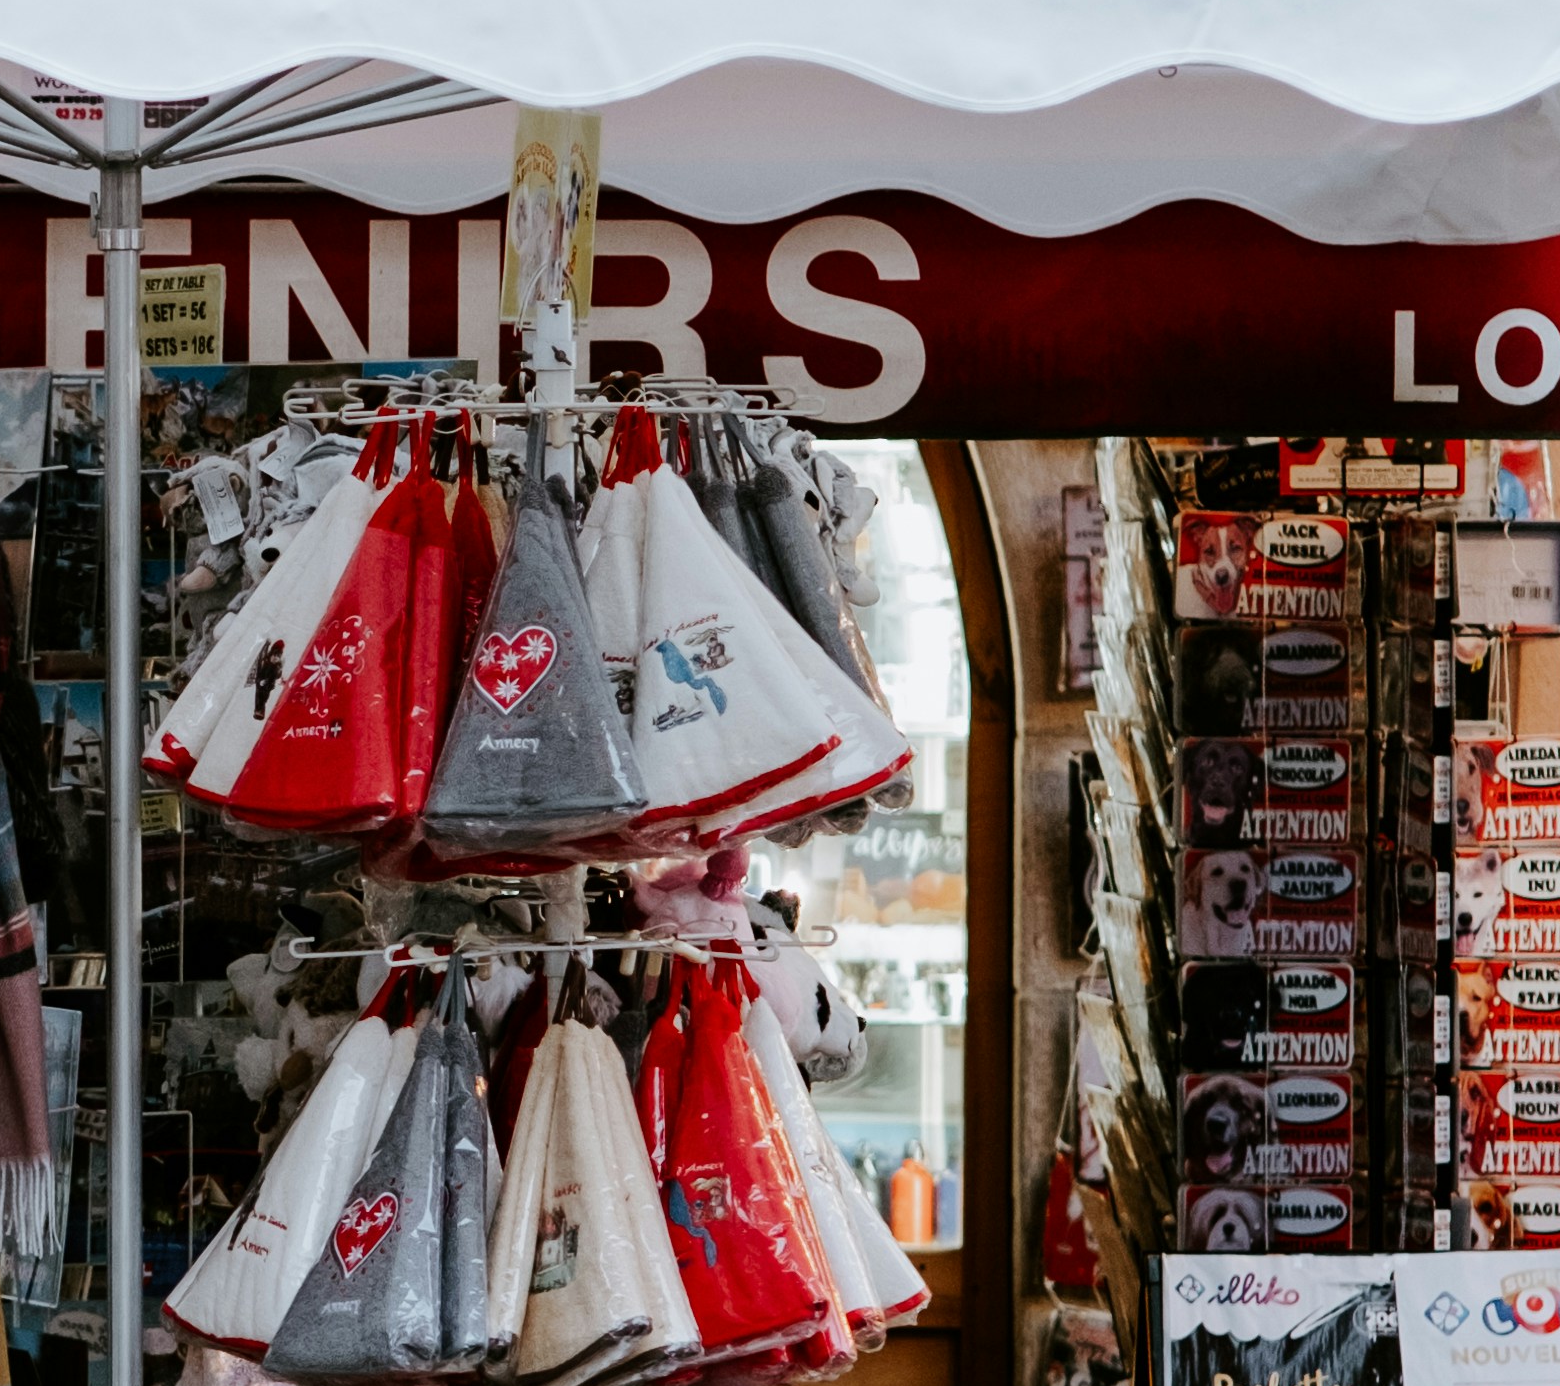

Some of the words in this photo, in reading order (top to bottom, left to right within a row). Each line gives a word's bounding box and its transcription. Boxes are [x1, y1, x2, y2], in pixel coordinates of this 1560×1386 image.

[144, 278, 161, 291] SET
[162, 277, 175, 290] DE
[177, 275, 206, 290] TABLE
[152, 303, 176, 322] SET
[190, 300, 207, 320] 5€
[145, 337, 179, 358] SETS
[191, 334, 215, 355] 18€
[1278, 523, 1320, 540] JACK
[1268, 544, 1330, 560] RUSSEL
[1235, 584, 1346, 618] ATTENTION
[1241, 696, 1348, 728] ATTENTION
[478, 734, 541, 754] Annecy
[1239, 808, 1348, 841] ATTENTION
[1270, 861, 1344, 878] LABRADOR
[1280, 881, 1335, 897] JAUNE
[1528, 879, 1557, 893] INU
[1243, 919, 1354, 954] ATTENTION
[1241, 1032, 1349, 1063] ATTENTION
[1277, 1092, 1340, 1108] LEONBERG
[1242, 1142, 1350, 1175] ATTENTION
[1207, 1272, 1301, 1307] illiko
